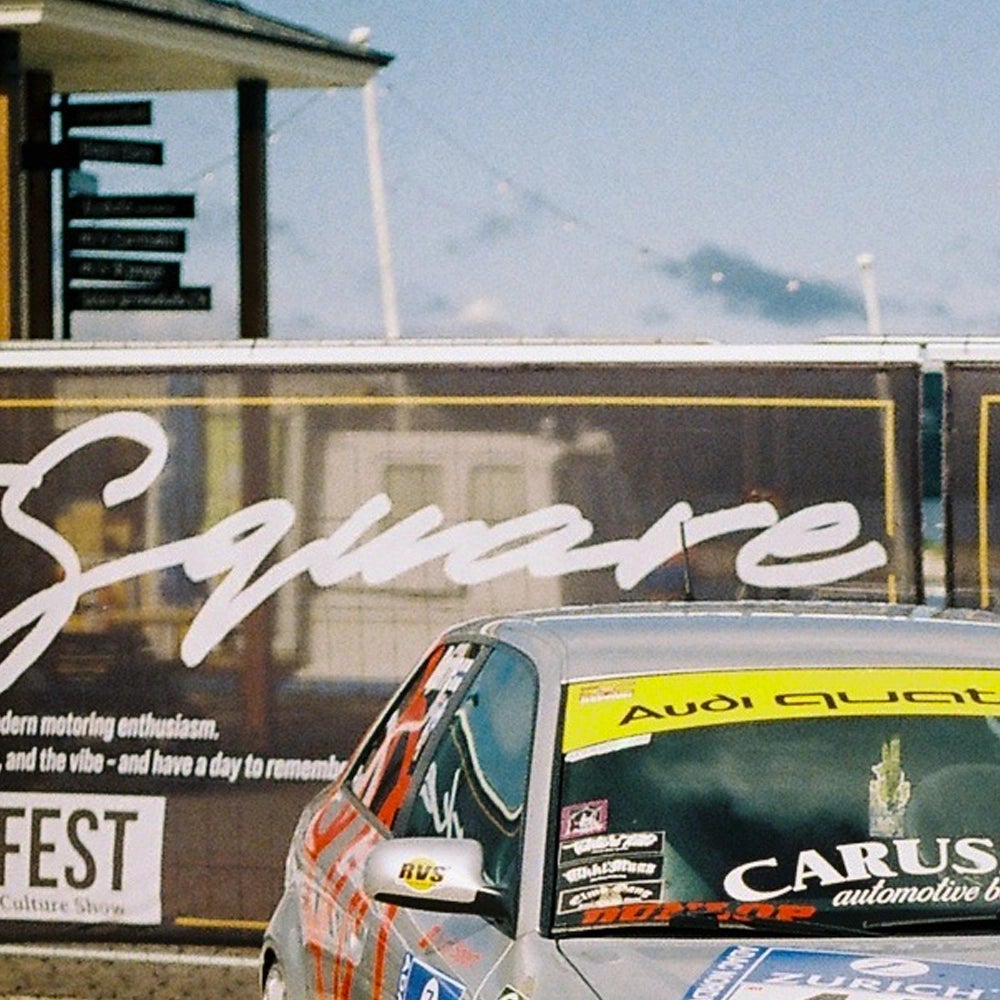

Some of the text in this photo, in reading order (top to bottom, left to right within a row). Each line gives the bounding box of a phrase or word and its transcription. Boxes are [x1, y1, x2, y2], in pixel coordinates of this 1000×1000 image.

[618, 694, 752, 726] Audi
[40, 711, 116, 742] motoring
[117, 712, 220, 741] enthusiasm.
[6, 748, 36, 772] and
[40, 748, 65, 773] the
[69, 749, 105, 773] vibe
[119, 751, 149, 775] and
[152, 750, 193, 777] have
[195, 758, 207, 777] a
[209, 752, 244, 783] day
[245, 754, 264, 779] to
[0, 808, 138, 891] FEST
[398, 862, 446, 883] RVS
[832, 876, 979, 907] automotive
[765, 972, 987, 1000] ZURICH
